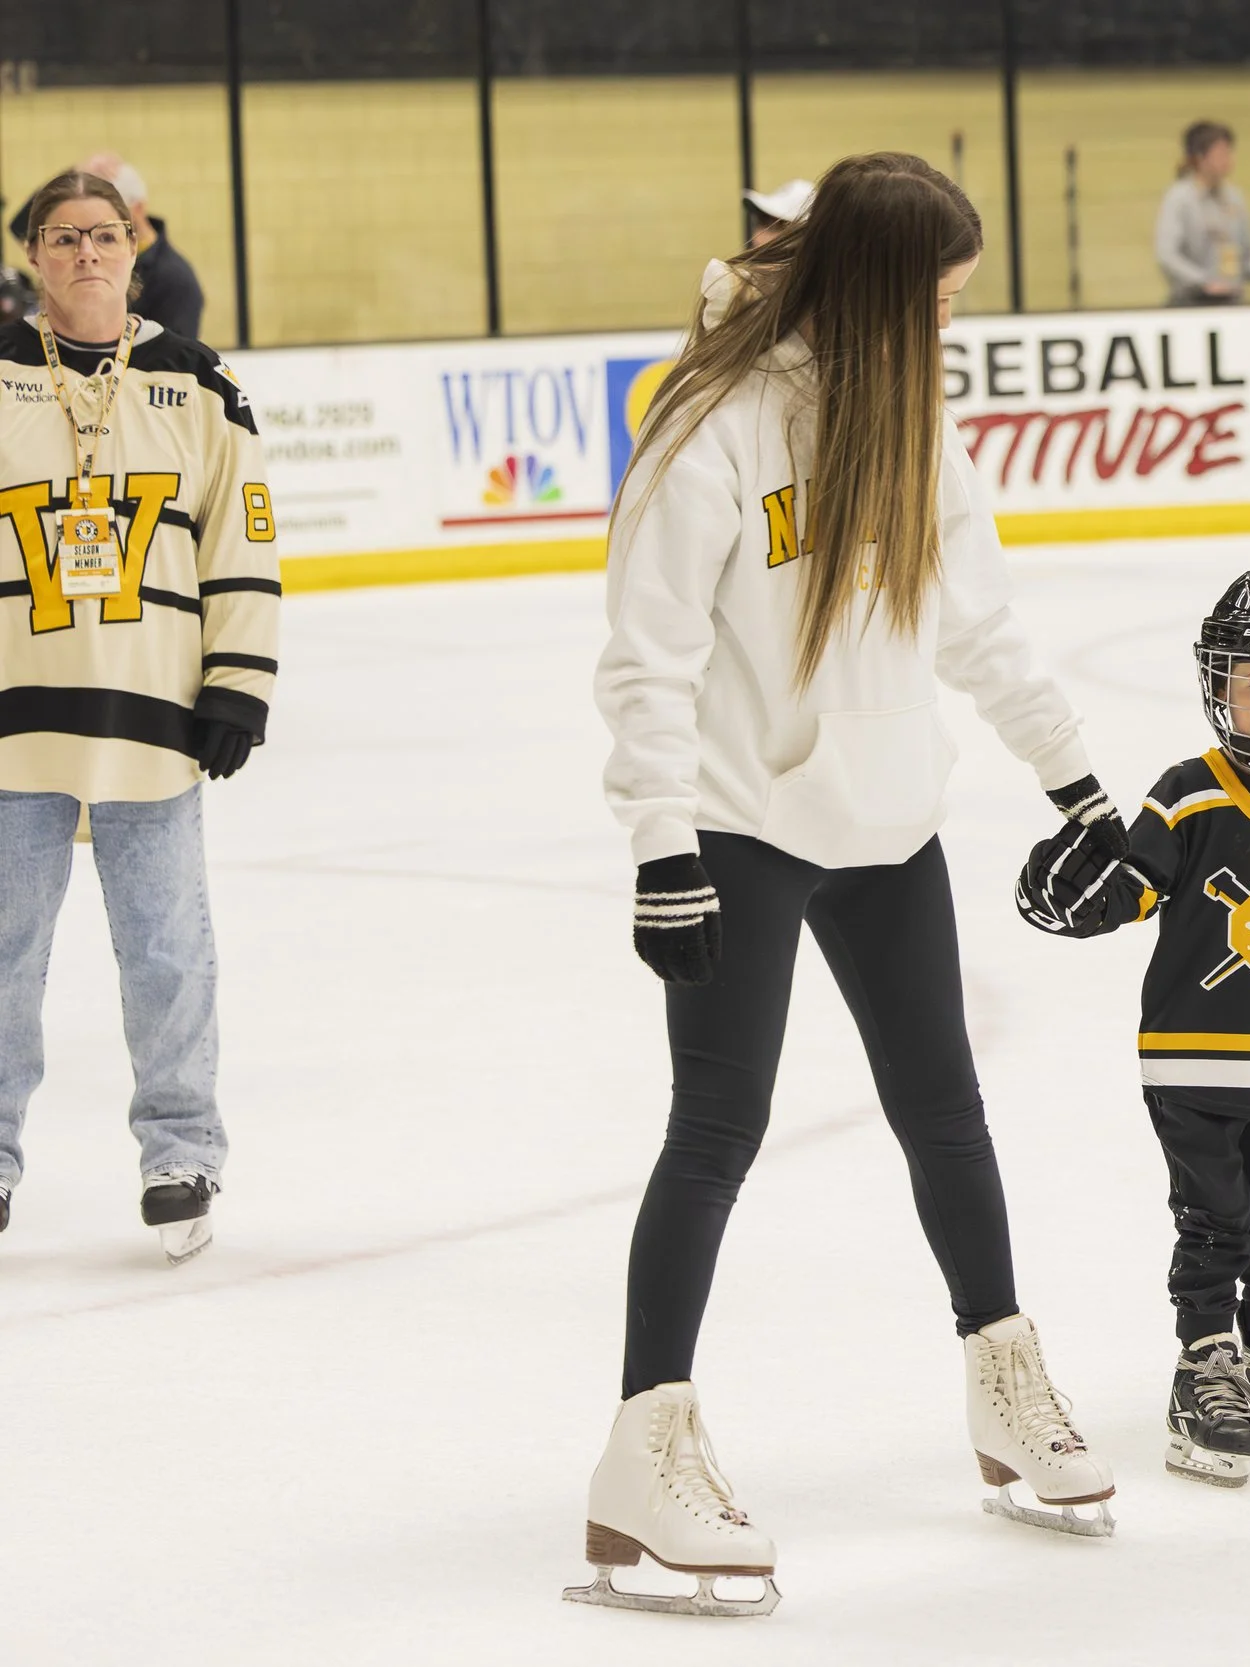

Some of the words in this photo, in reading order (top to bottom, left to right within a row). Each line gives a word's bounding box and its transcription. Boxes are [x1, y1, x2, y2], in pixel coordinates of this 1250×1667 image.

[14, 381, 43, 393] WVU
[16, 392, 60, 403] Medicin
[149, 385, 188, 409] Lite
[439, 365, 595, 464] WTOV
[242, 482, 276, 542] 8
[74, 545, 100, 556] SEASON
[74, 558, 102, 569] MEMBER
